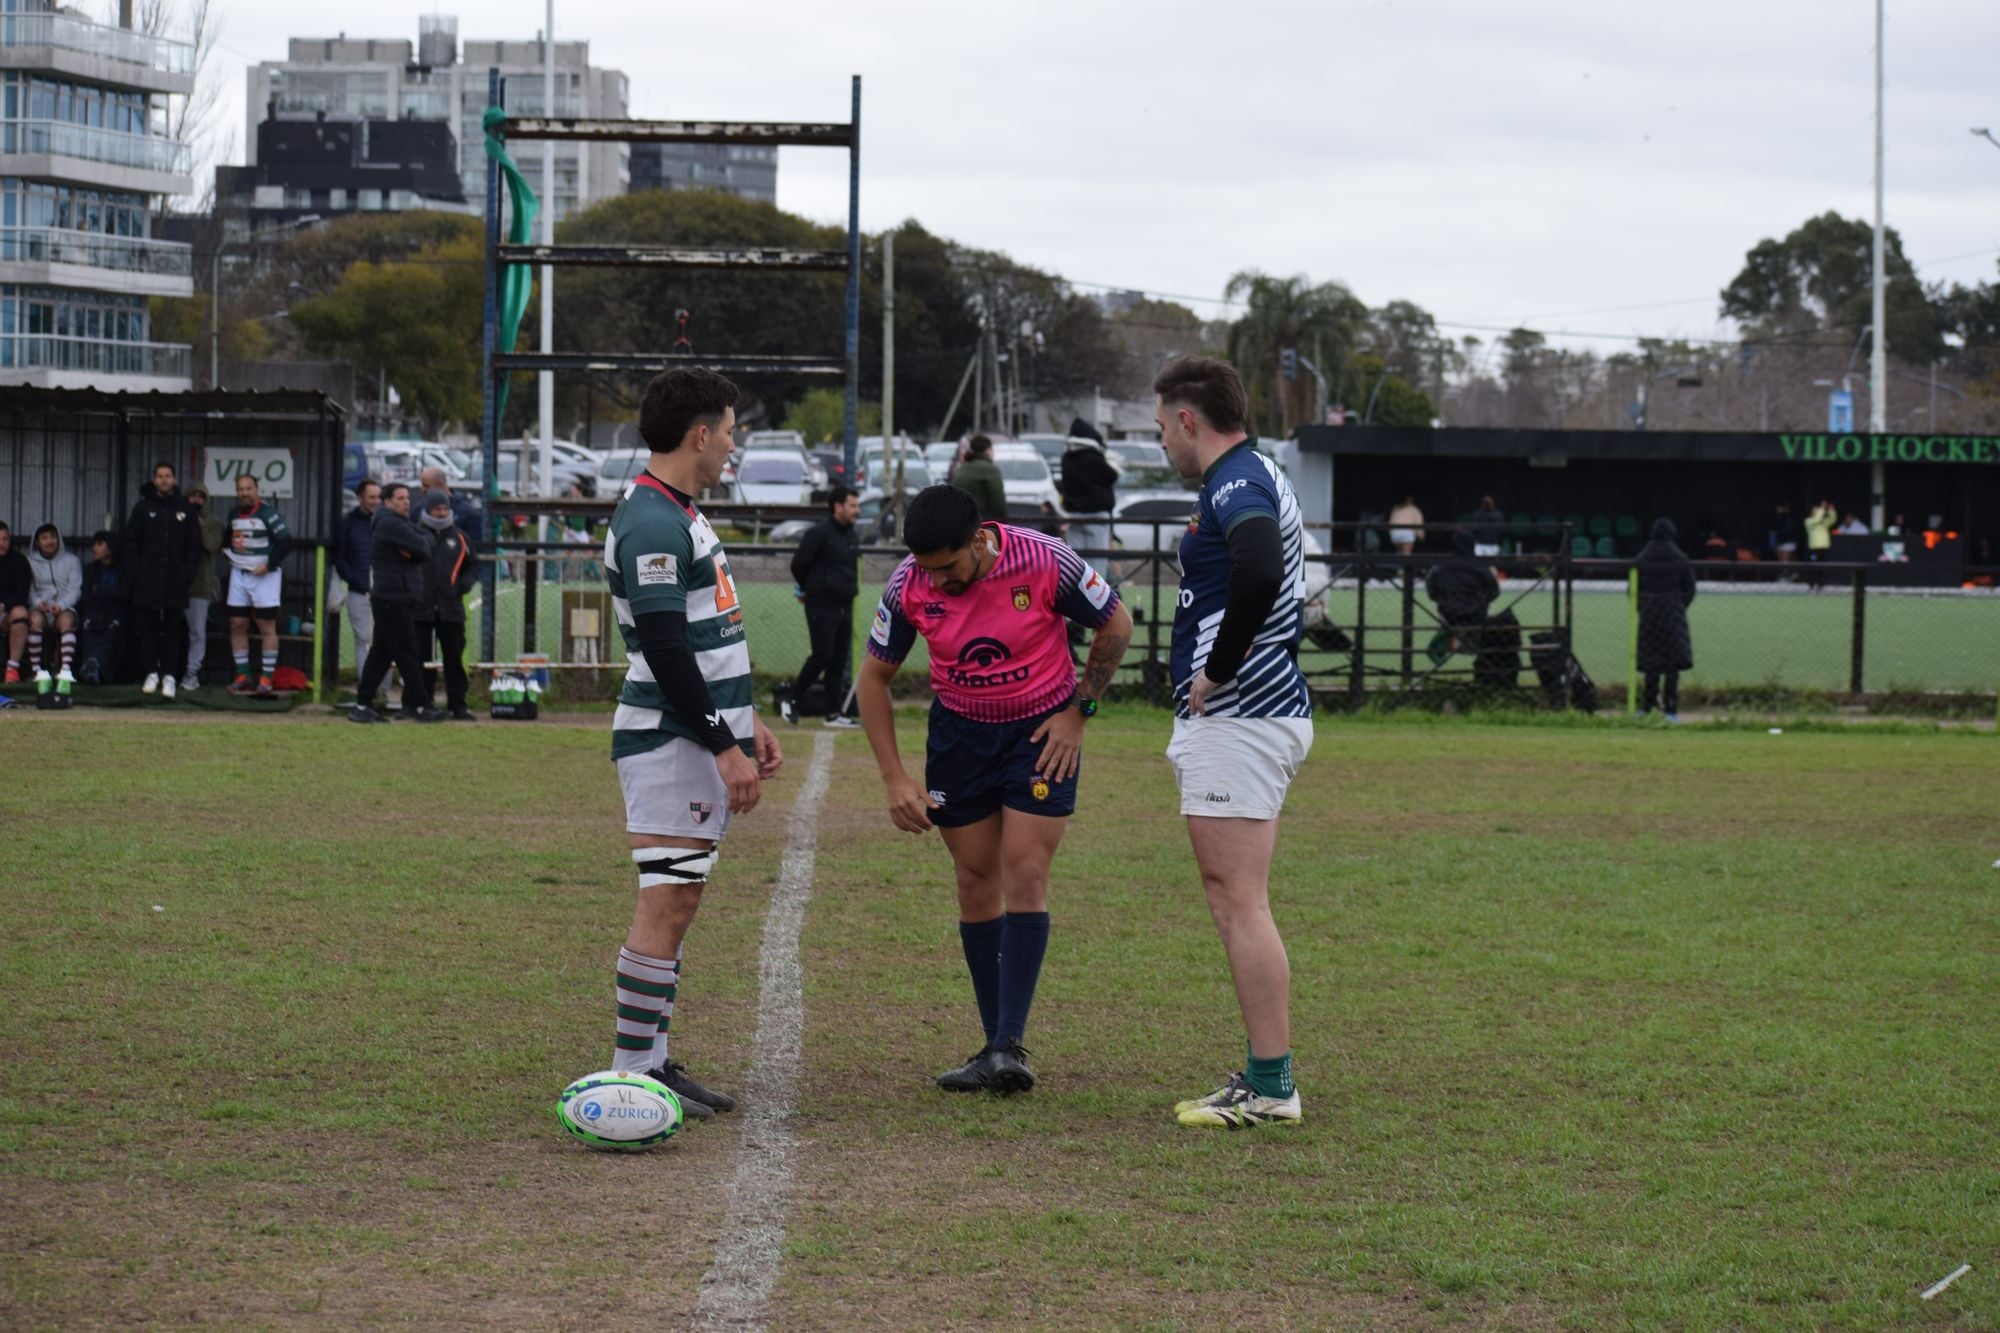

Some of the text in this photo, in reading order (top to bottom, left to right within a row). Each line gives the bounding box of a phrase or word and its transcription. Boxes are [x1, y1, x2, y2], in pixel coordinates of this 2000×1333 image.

[1779, 436, 1862, 460] VILO
[214, 459, 286, 482] VILO
[608, 1107, 658, 1120] ZURICH
